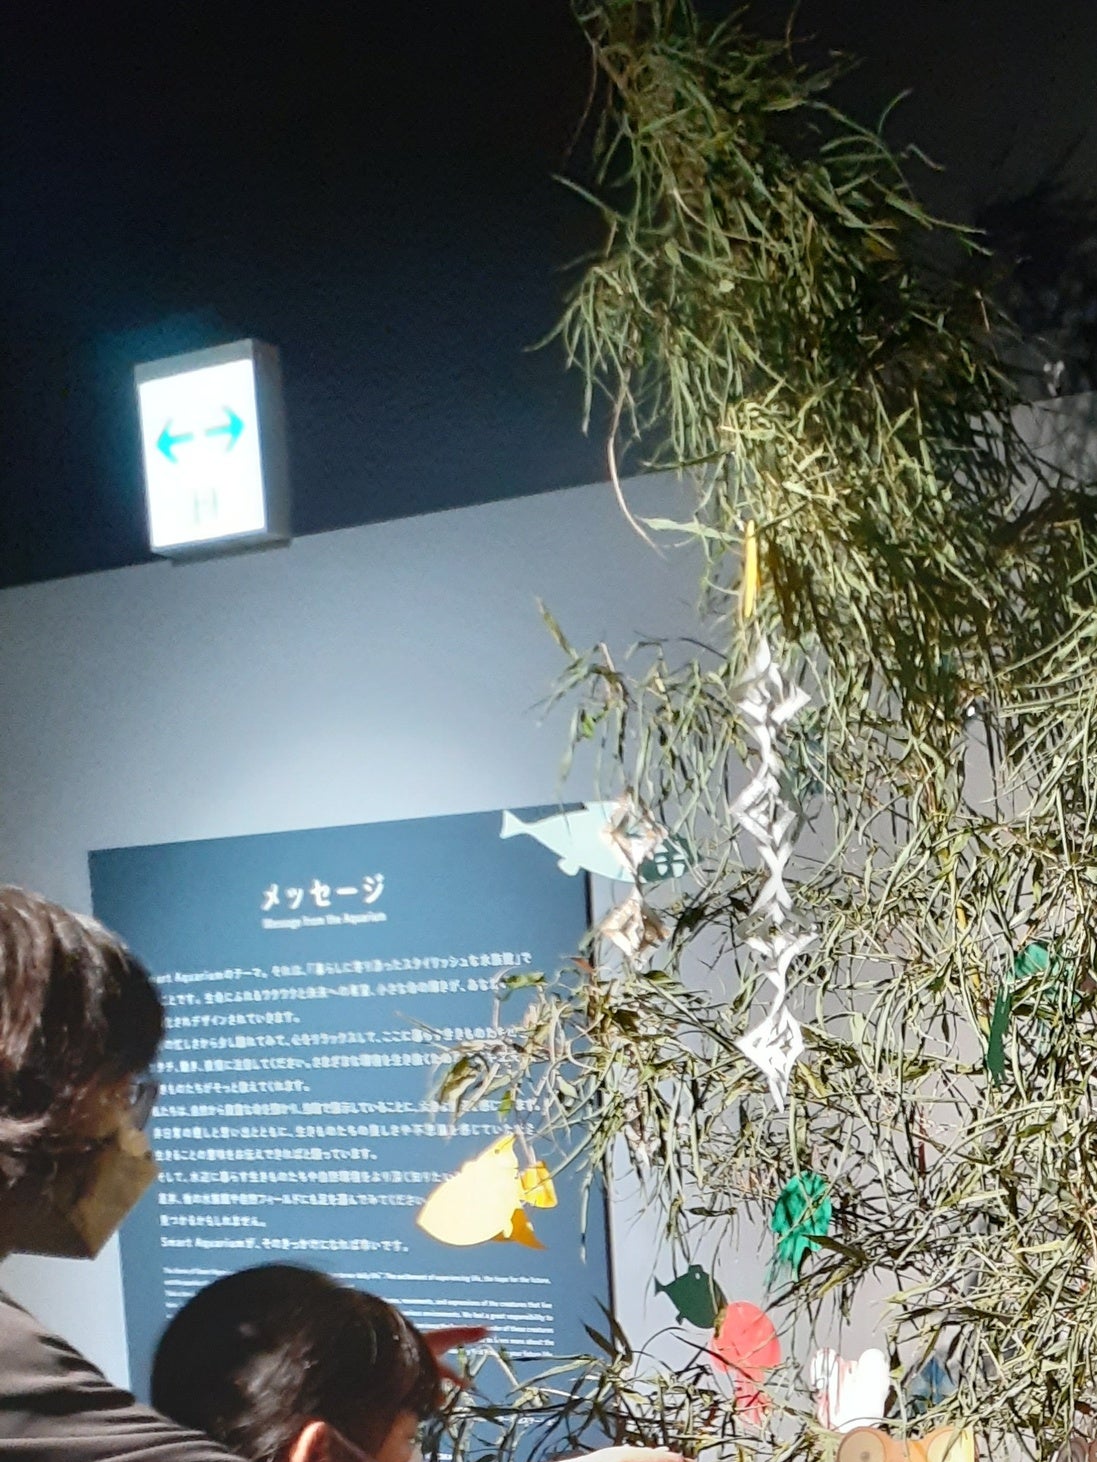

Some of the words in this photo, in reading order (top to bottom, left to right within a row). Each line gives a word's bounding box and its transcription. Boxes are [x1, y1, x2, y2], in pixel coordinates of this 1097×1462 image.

[261, 873, 384, 911] メッセージ
